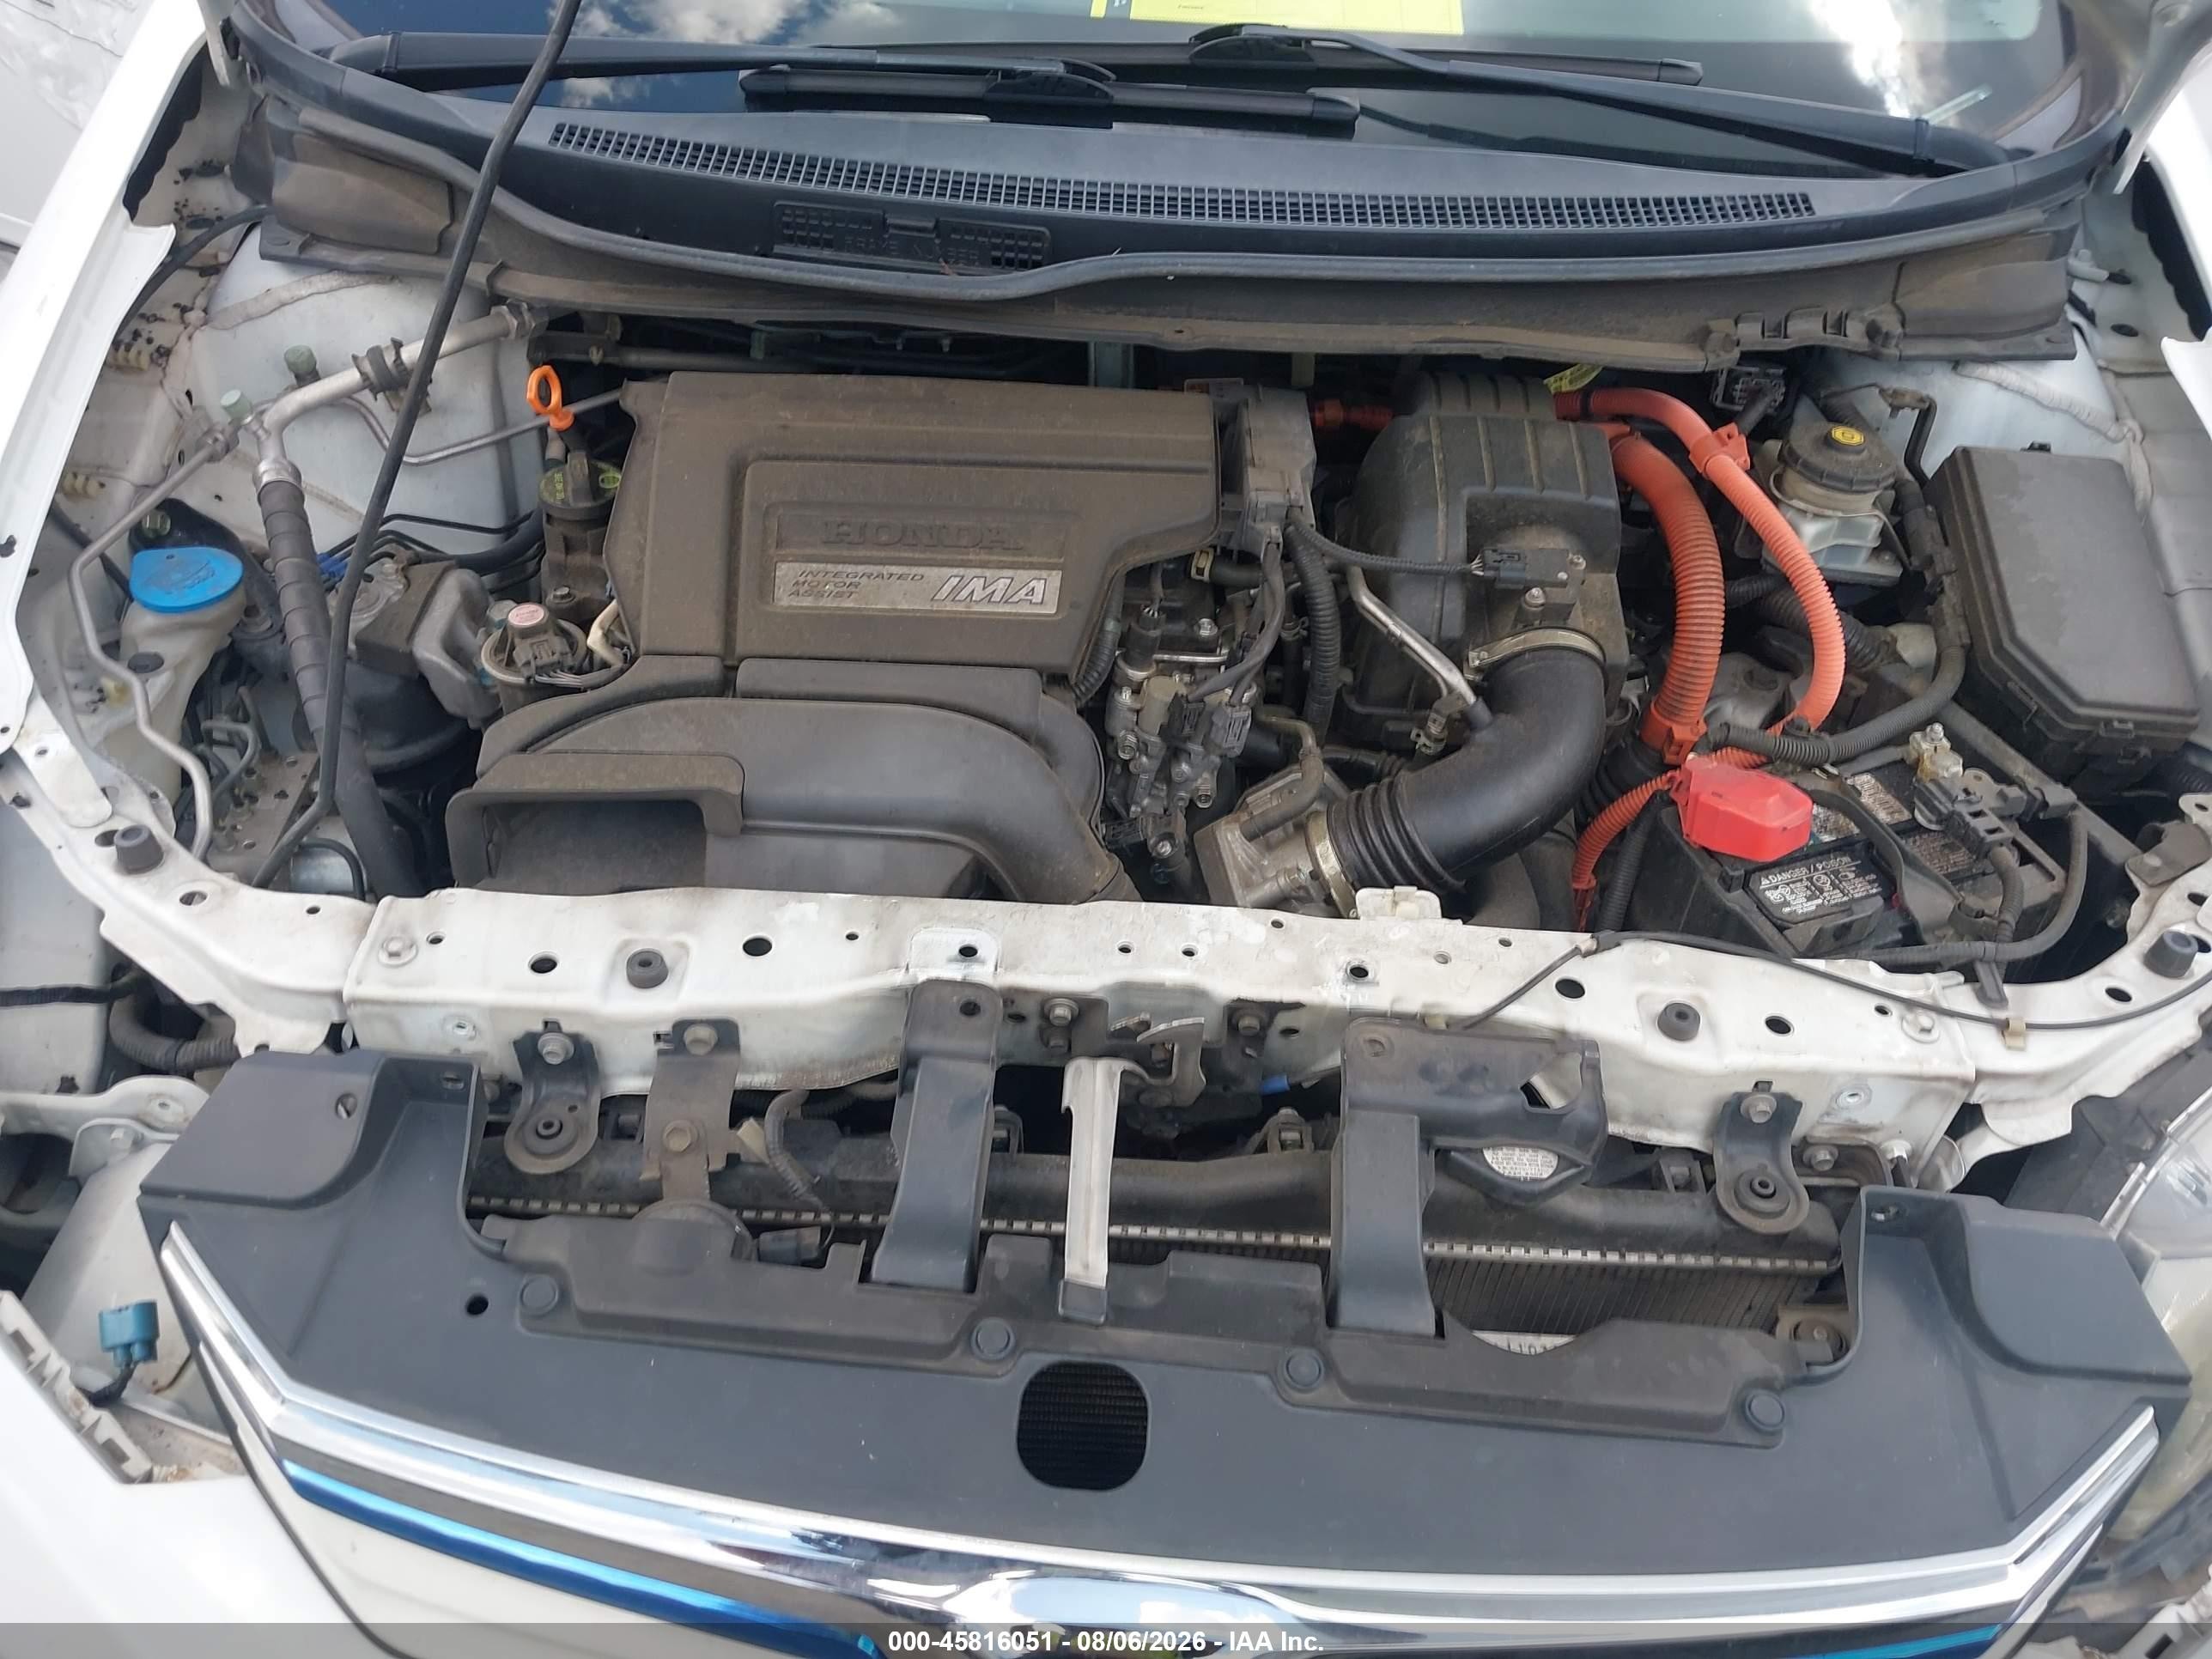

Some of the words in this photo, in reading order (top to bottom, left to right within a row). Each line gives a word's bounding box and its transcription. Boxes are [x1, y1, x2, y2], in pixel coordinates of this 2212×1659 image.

[822, 520, 1024, 551] HONDA
[792, 579, 861, 591] MOTOR
[799, 570, 925, 582] INTEGRATED
[788, 589, 858, 600] ASSIST
[932, 575, 1047, 605] IMA
[1769, 866, 1809, 883] DANGER
[1815, 855, 1852, 871] POISON
